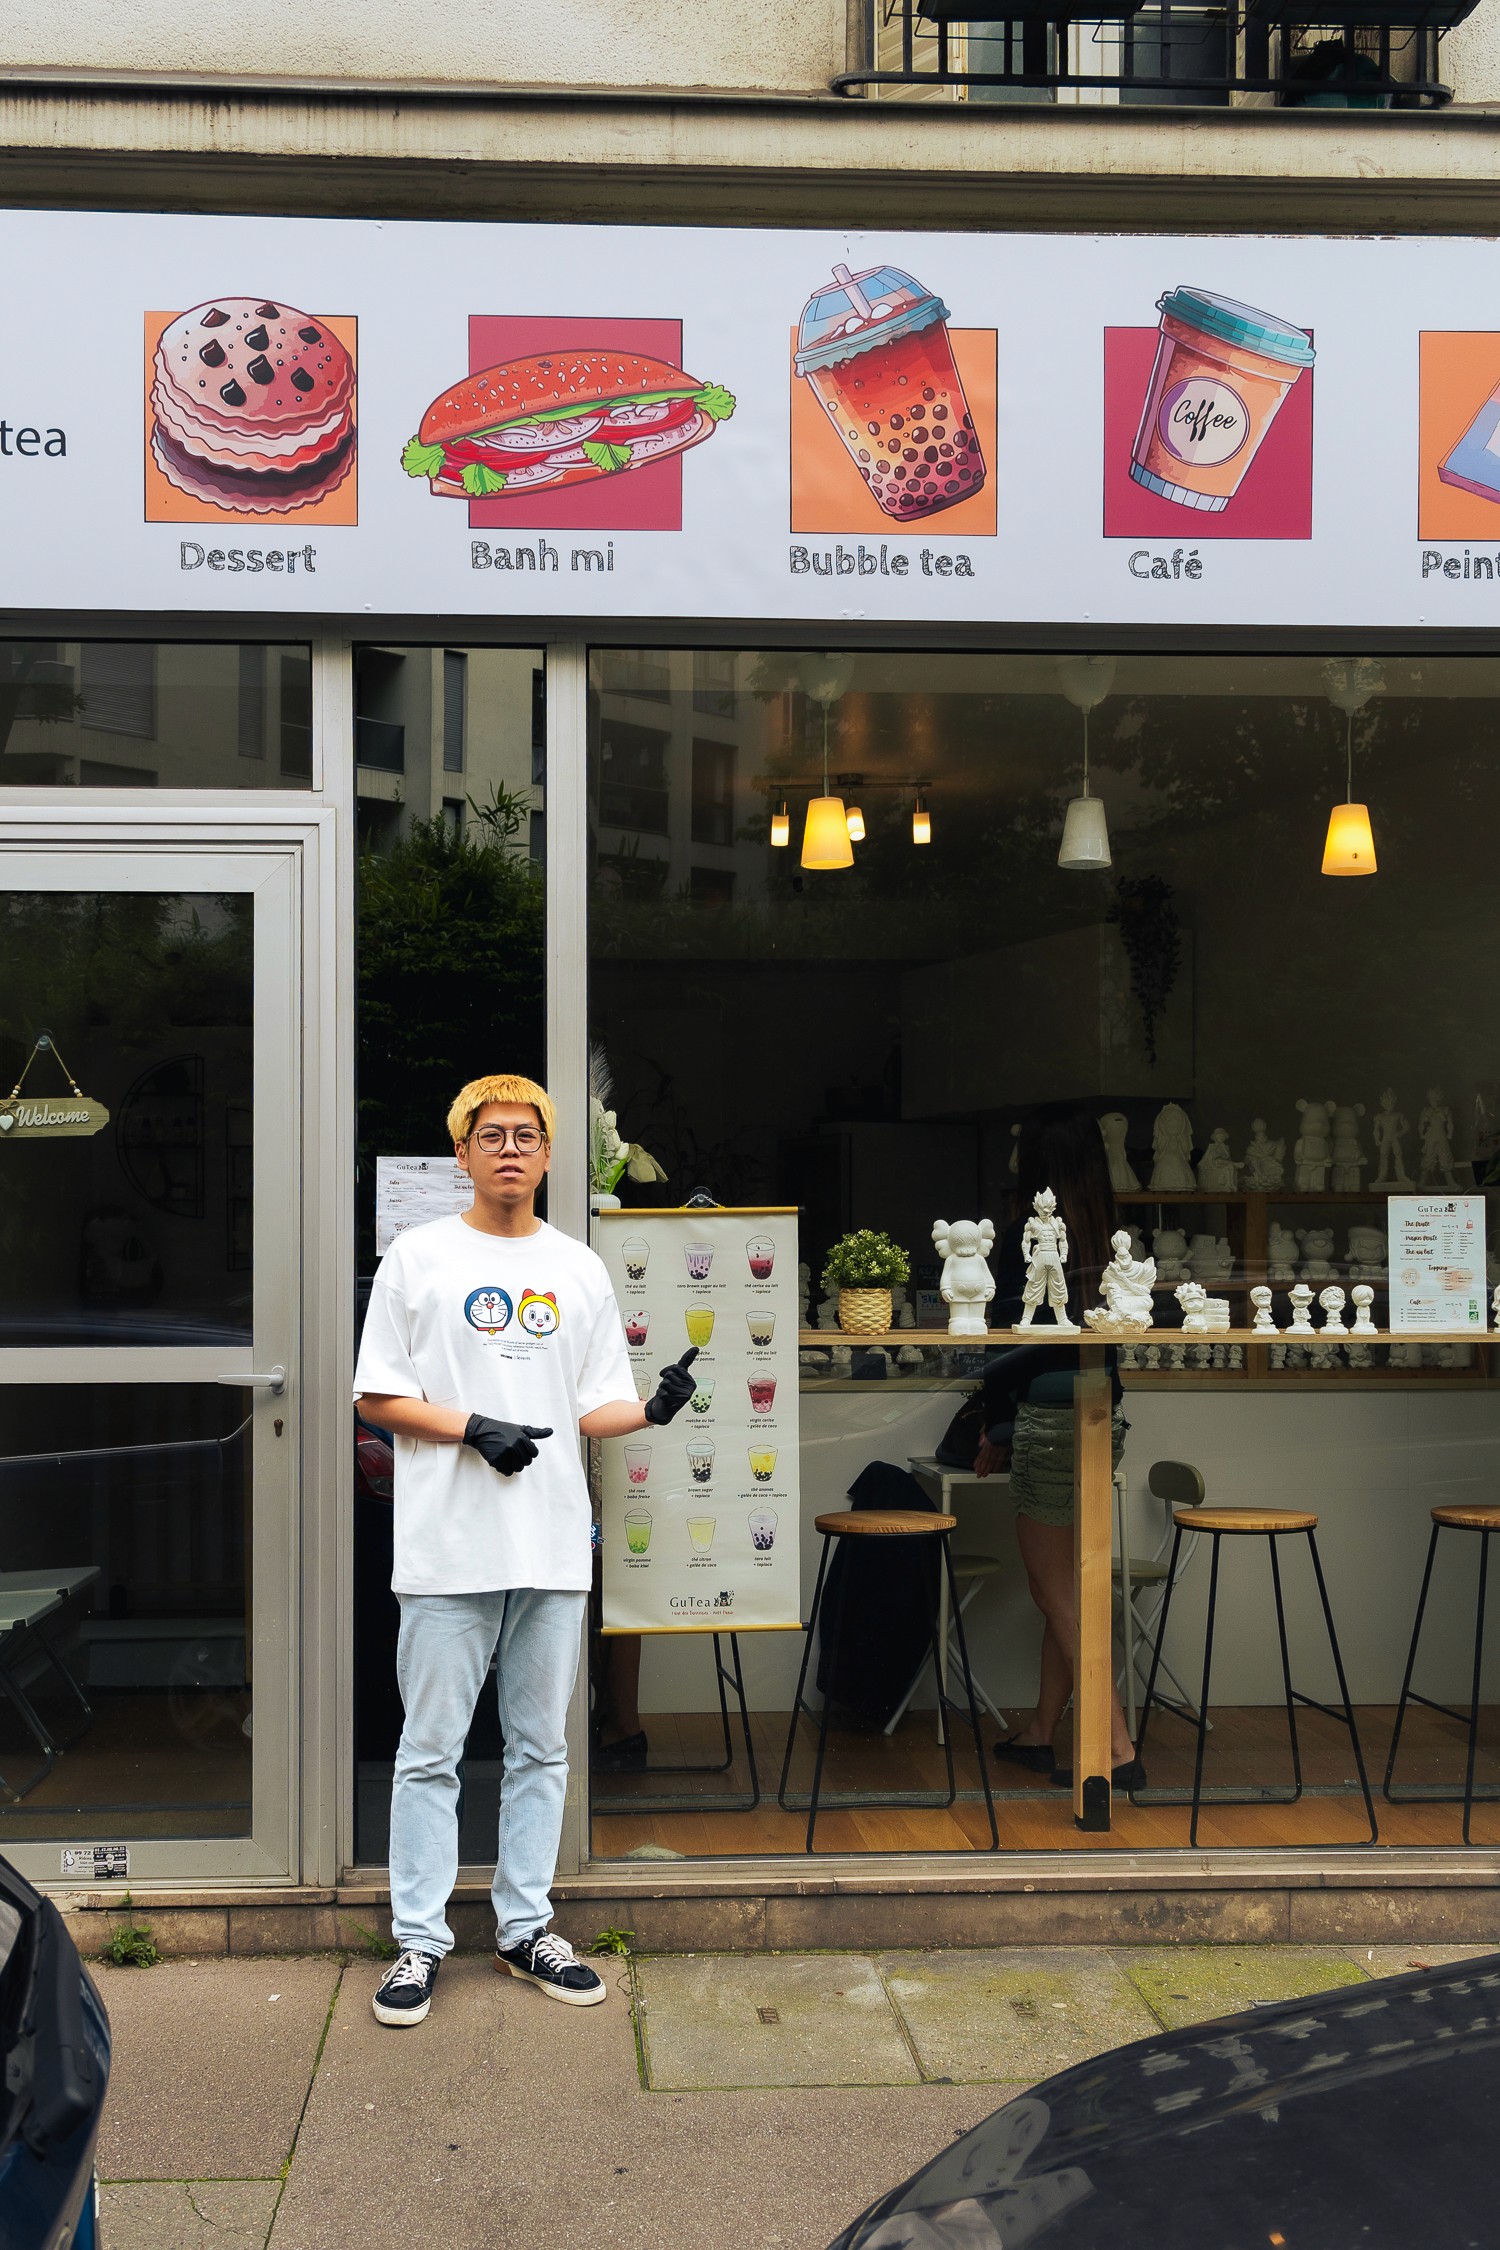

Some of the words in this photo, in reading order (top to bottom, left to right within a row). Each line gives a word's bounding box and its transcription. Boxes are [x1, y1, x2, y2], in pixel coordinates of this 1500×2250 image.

[0, 416, 67, 457] tea
[1174, 399, 1237, 443] Coffee
[180, 541, 317, 575] Dessert
[471, 538, 559, 572] Banh
[571, 541, 614, 572] mi
[789, 543, 910, 577] Bubble
[919, 548, 976, 578] tea
[1128, 547, 1203, 580] Café
[16, 1104, 90, 1127] Welcome
[670, 1596, 710, 1608] GuTea
